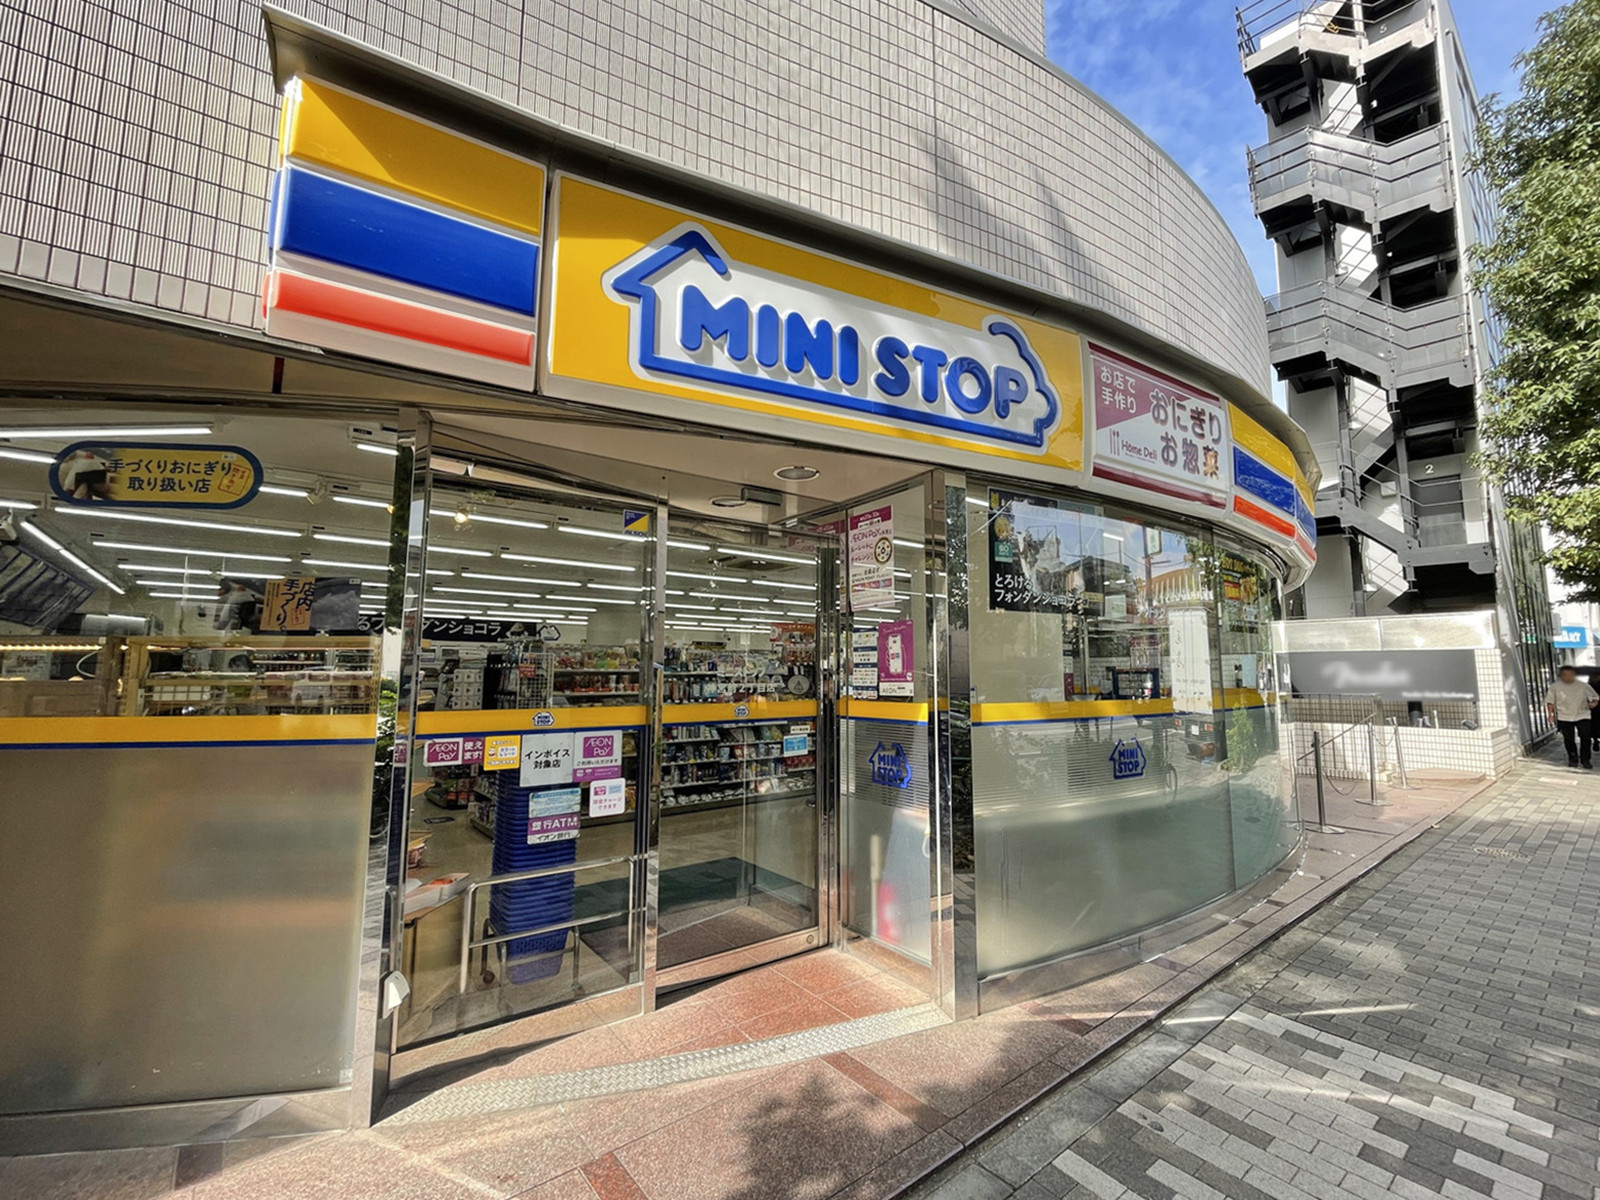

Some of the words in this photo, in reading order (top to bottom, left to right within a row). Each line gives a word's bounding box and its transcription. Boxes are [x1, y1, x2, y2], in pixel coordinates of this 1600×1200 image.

[679, 284, 859, 386] MINI
[873, 335, 1029, 419] STOP
[1100, 365, 1137, 394] お店で
[1101, 387, 1138, 414] 手作り
[1149, 388, 1223, 446] おにぎり
[1121, 439, 1143, 456] Home
[1143, 446, 1158, 460] Deli
[1160, 432, 1220, 480] お惣菜
[107, 458, 233, 477] 手づくりおにぎり
[1425, 463, 1435, 474] 2
[126, 475, 212, 494] 取り扱い店
[994, 573, 1035, 590] とろける
[296, 581, 317, 612] 店内
[464, 741, 483, 750] 使え
[525, 748, 571, 760] インボイス
[1118, 747, 1139, 761] MINI
[533, 759, 561, 770] 対象店
[1118, 760, 1140, 775] STOP
[531, 816, 578, 832] 銀行ATM
[537, 831, 571, 842] イオン銀行
